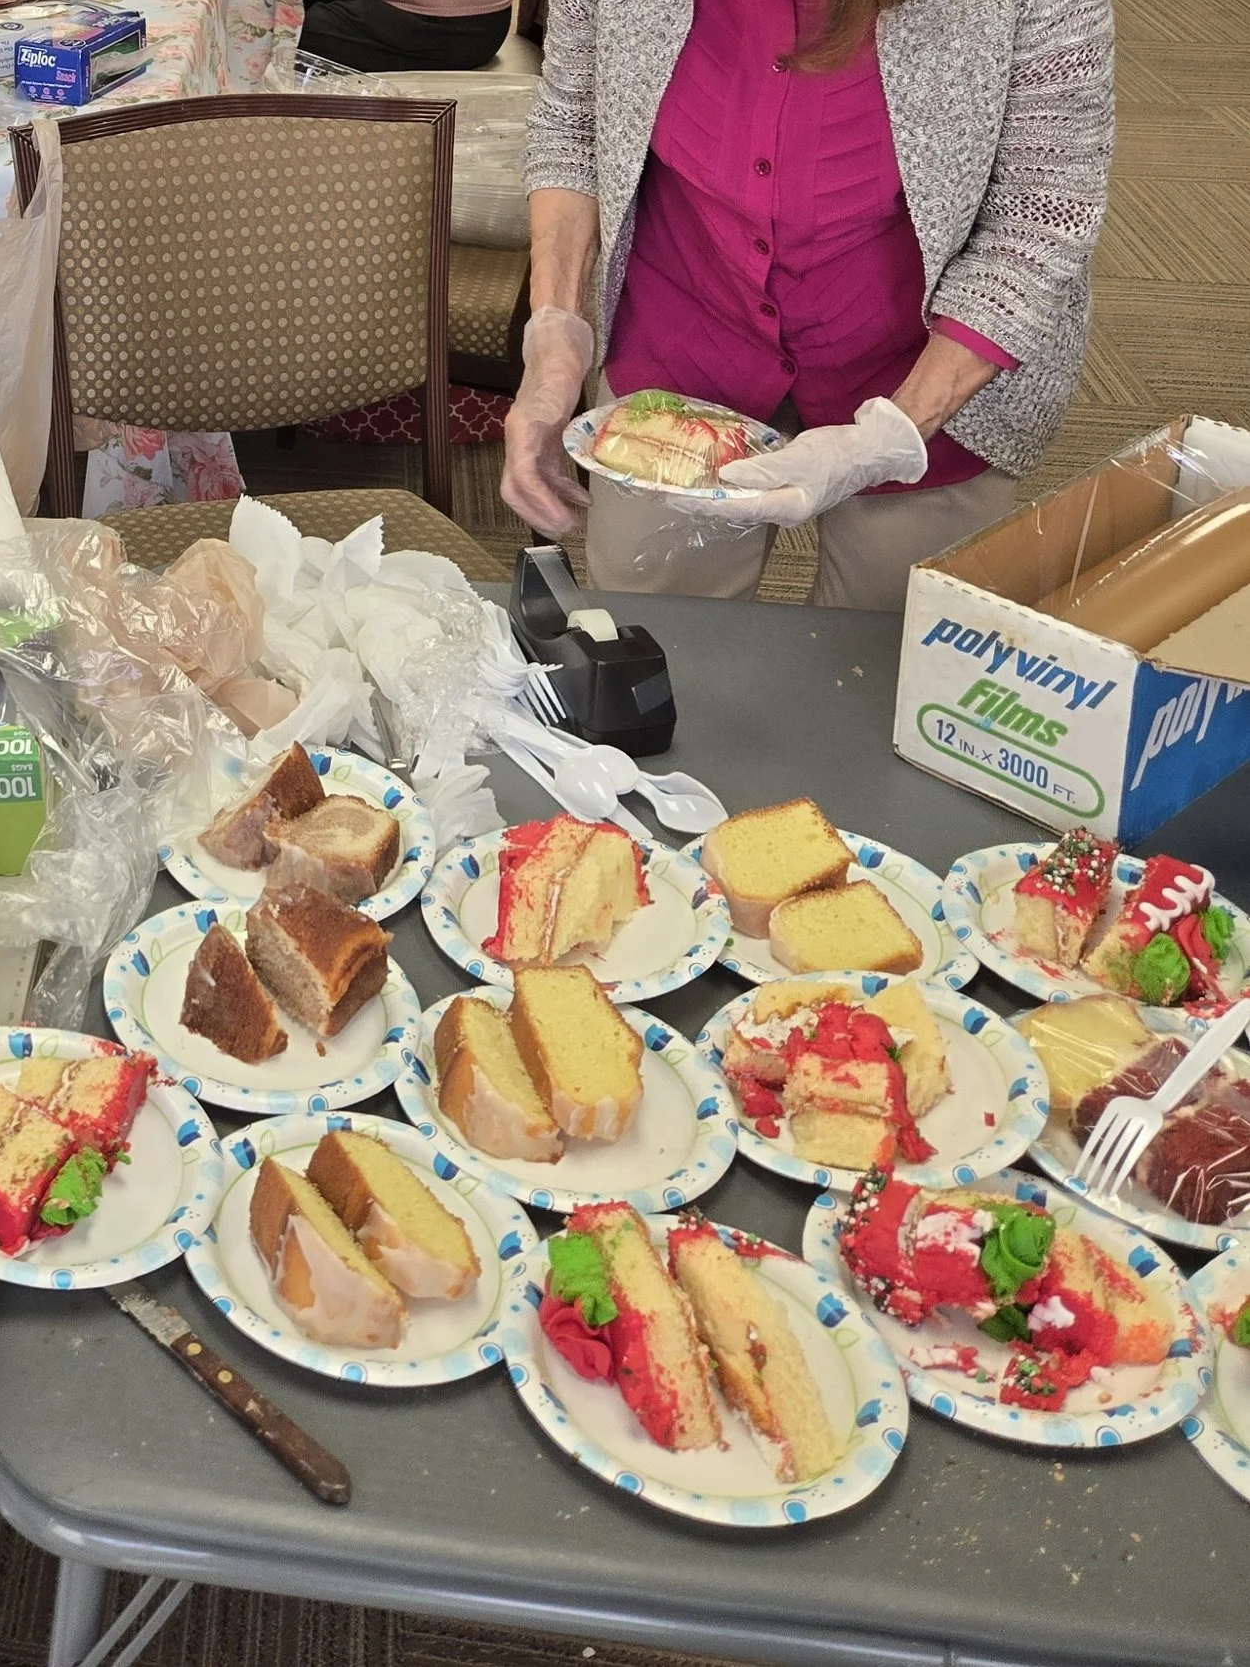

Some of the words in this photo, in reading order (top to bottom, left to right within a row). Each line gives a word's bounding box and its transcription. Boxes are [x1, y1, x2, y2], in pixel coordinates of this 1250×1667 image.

[20, 48, 57, 67] Ziploc
[920, 617, 1118, 711] polyvinyl
[956, 678, 1069, 748] Films
[1129, 677, 1244, 792] poly
[11, 763, 33, 771] BAGS
[935, 719, 957, 745] 12
[958, 738, 979, 759] IN.
[997, 747, 1049, 790] 3000
[1052, 785, 1077, 804] FT.
